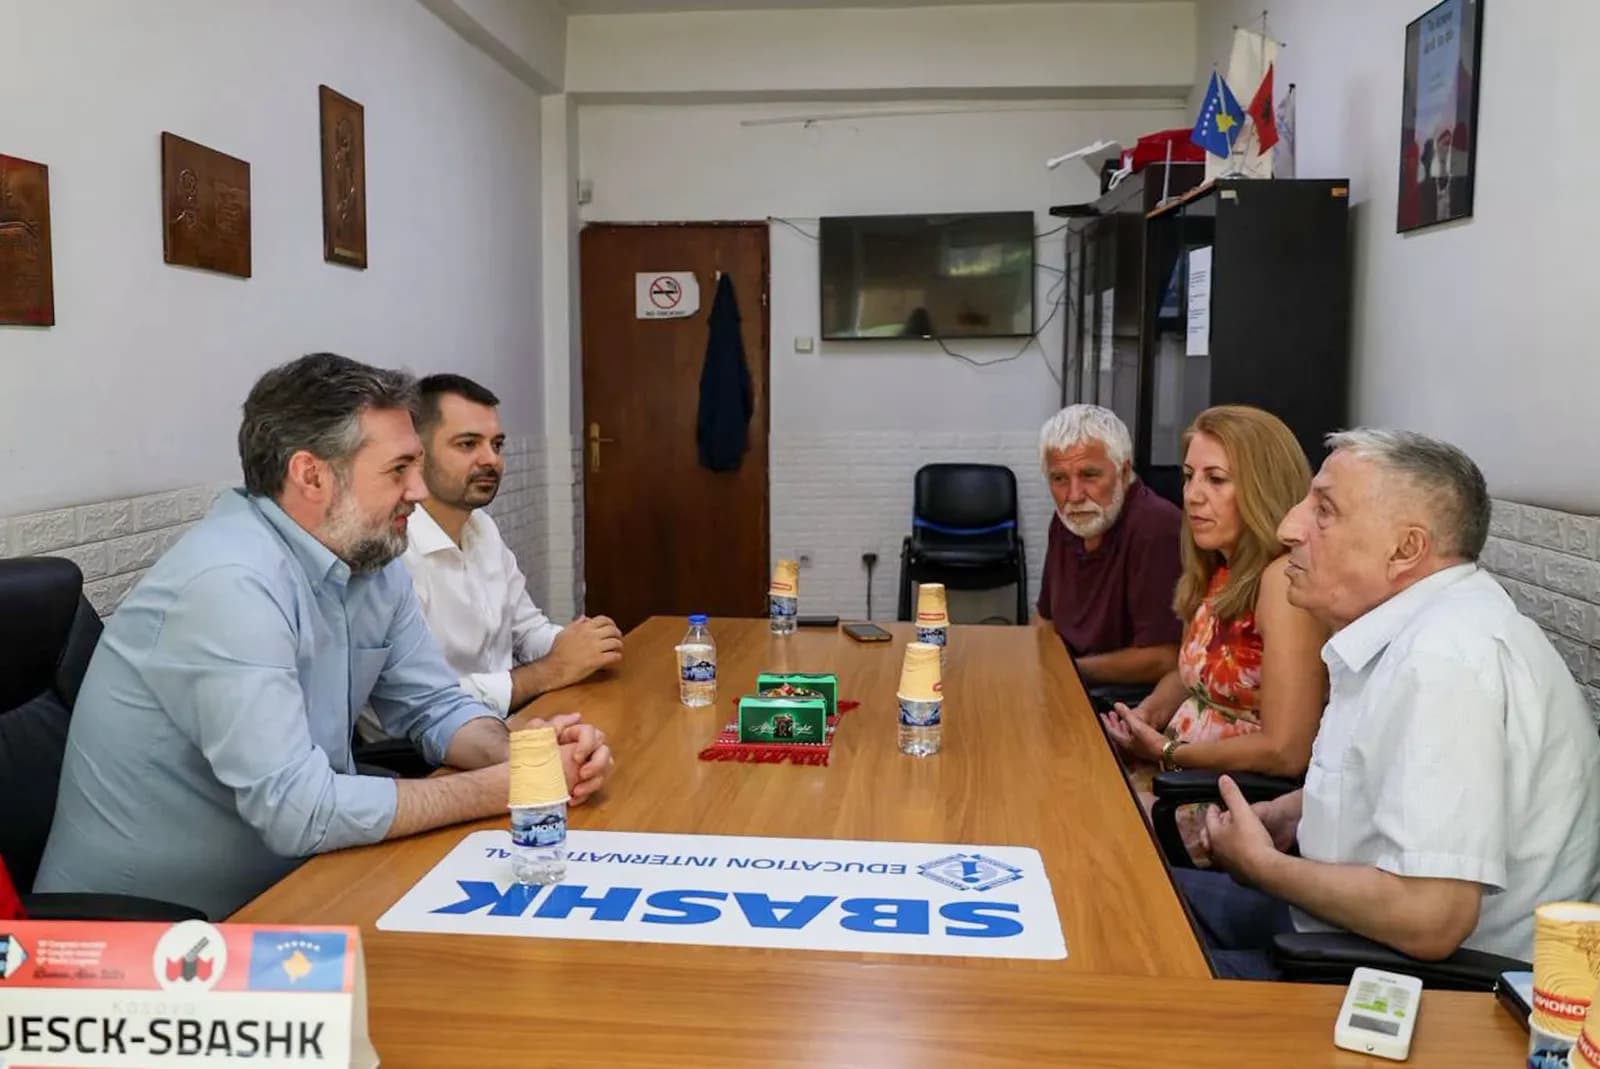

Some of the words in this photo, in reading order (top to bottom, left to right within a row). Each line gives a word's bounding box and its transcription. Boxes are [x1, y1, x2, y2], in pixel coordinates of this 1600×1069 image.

[484, 846, 716, 868] INTERNATIAL
[729, 858, 907, 874] EDUCATION
[429, 879, 1024, 938] SBASHK
